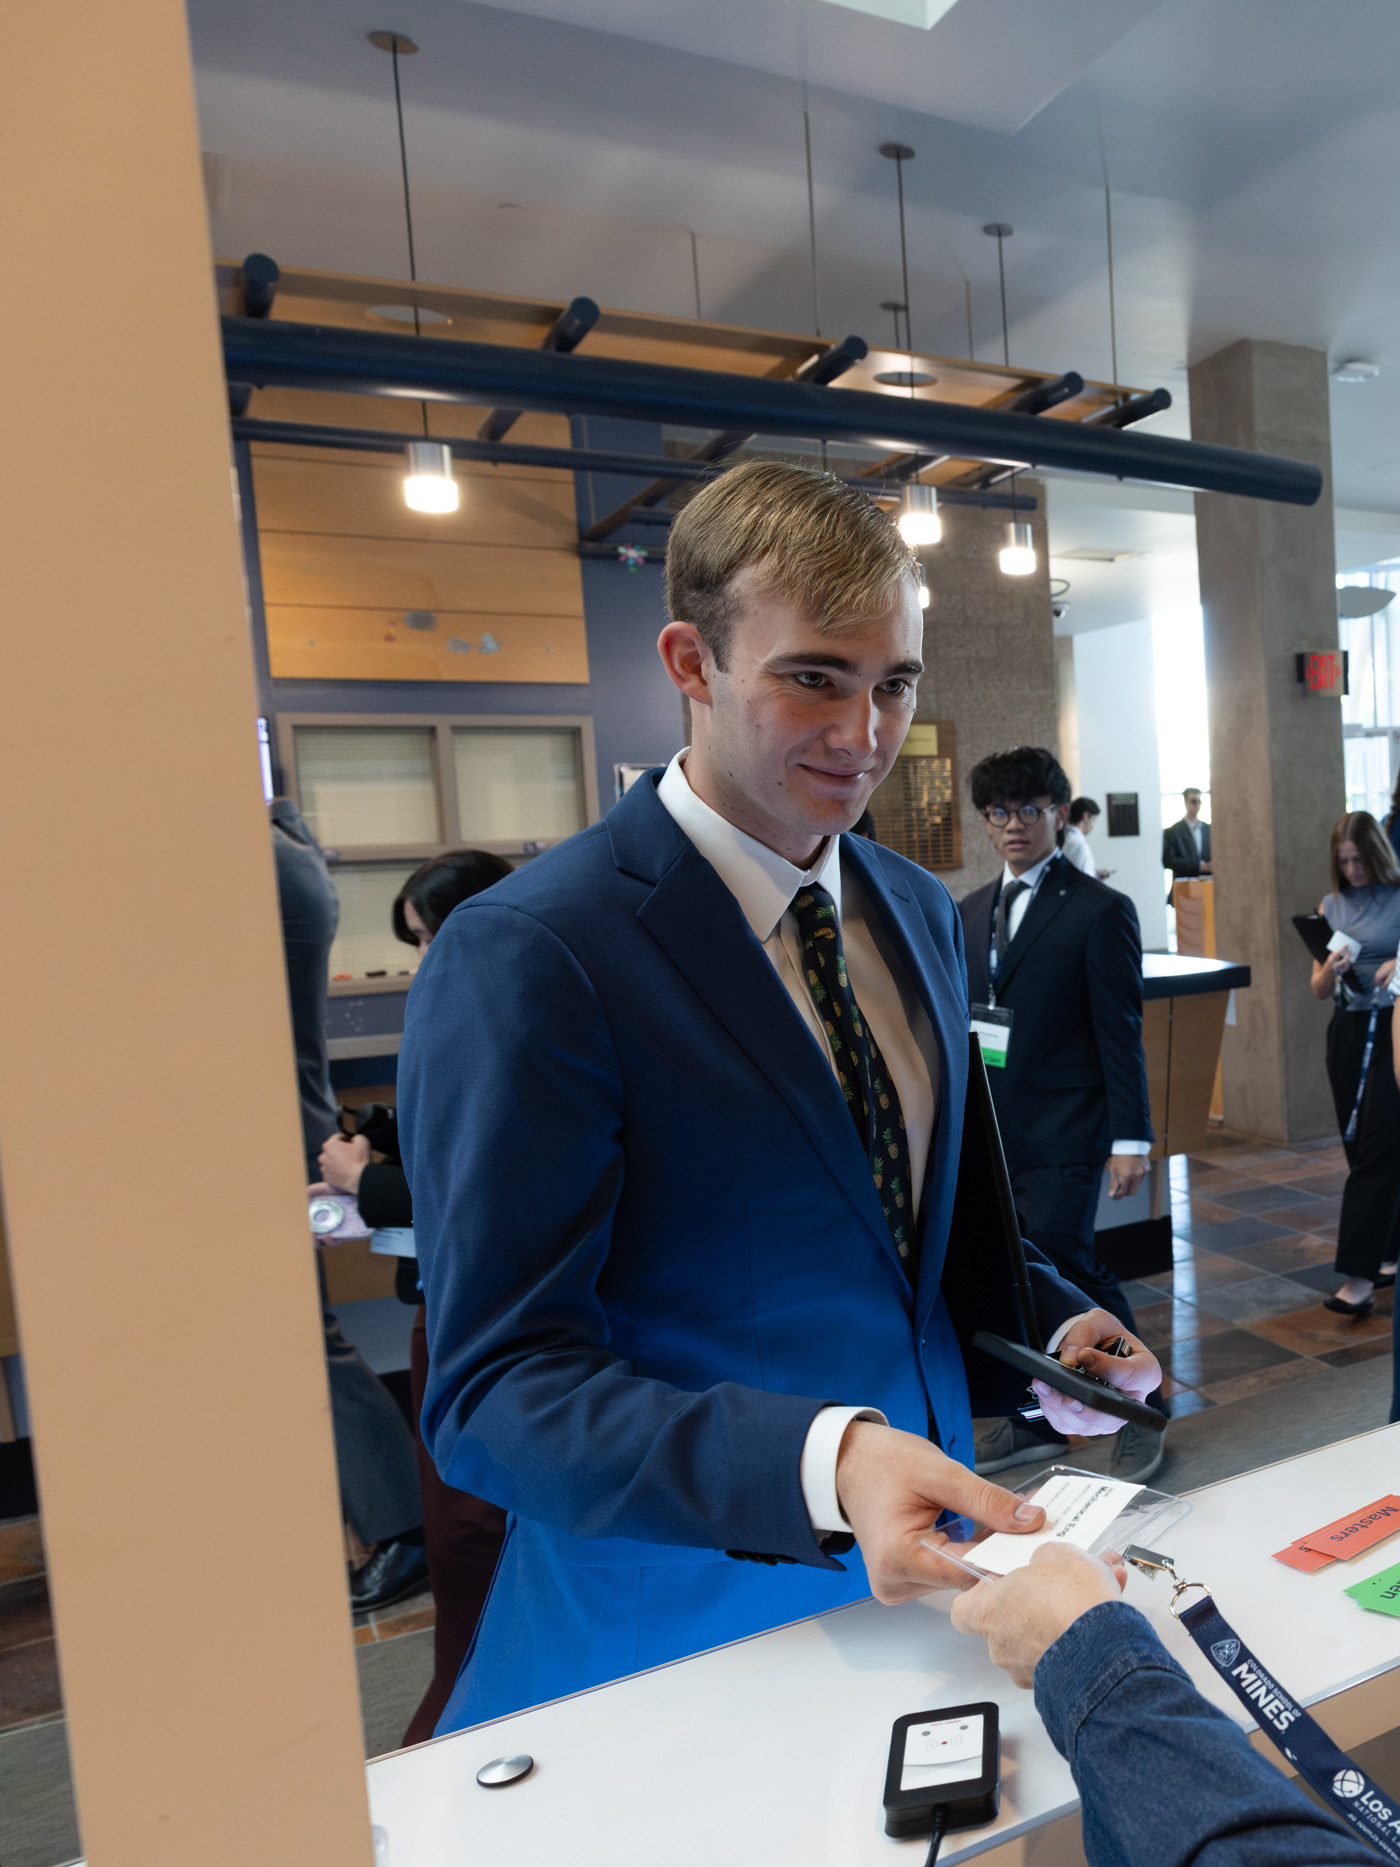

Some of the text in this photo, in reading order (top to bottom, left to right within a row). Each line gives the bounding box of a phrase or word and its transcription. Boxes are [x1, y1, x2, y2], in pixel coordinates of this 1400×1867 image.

[1310, 654, 1335, 689] EXIT
[1330, 1506, 1400, 1542] Masters
[1231, 1662, 1295, 1732] MINES
[1247, 1659, 1302, 1718] COLORADO SCHOOL OF
[1352, 1801, 1391, 1836] NATIONAL
[1360, 1790, 1393, 1821] Los
